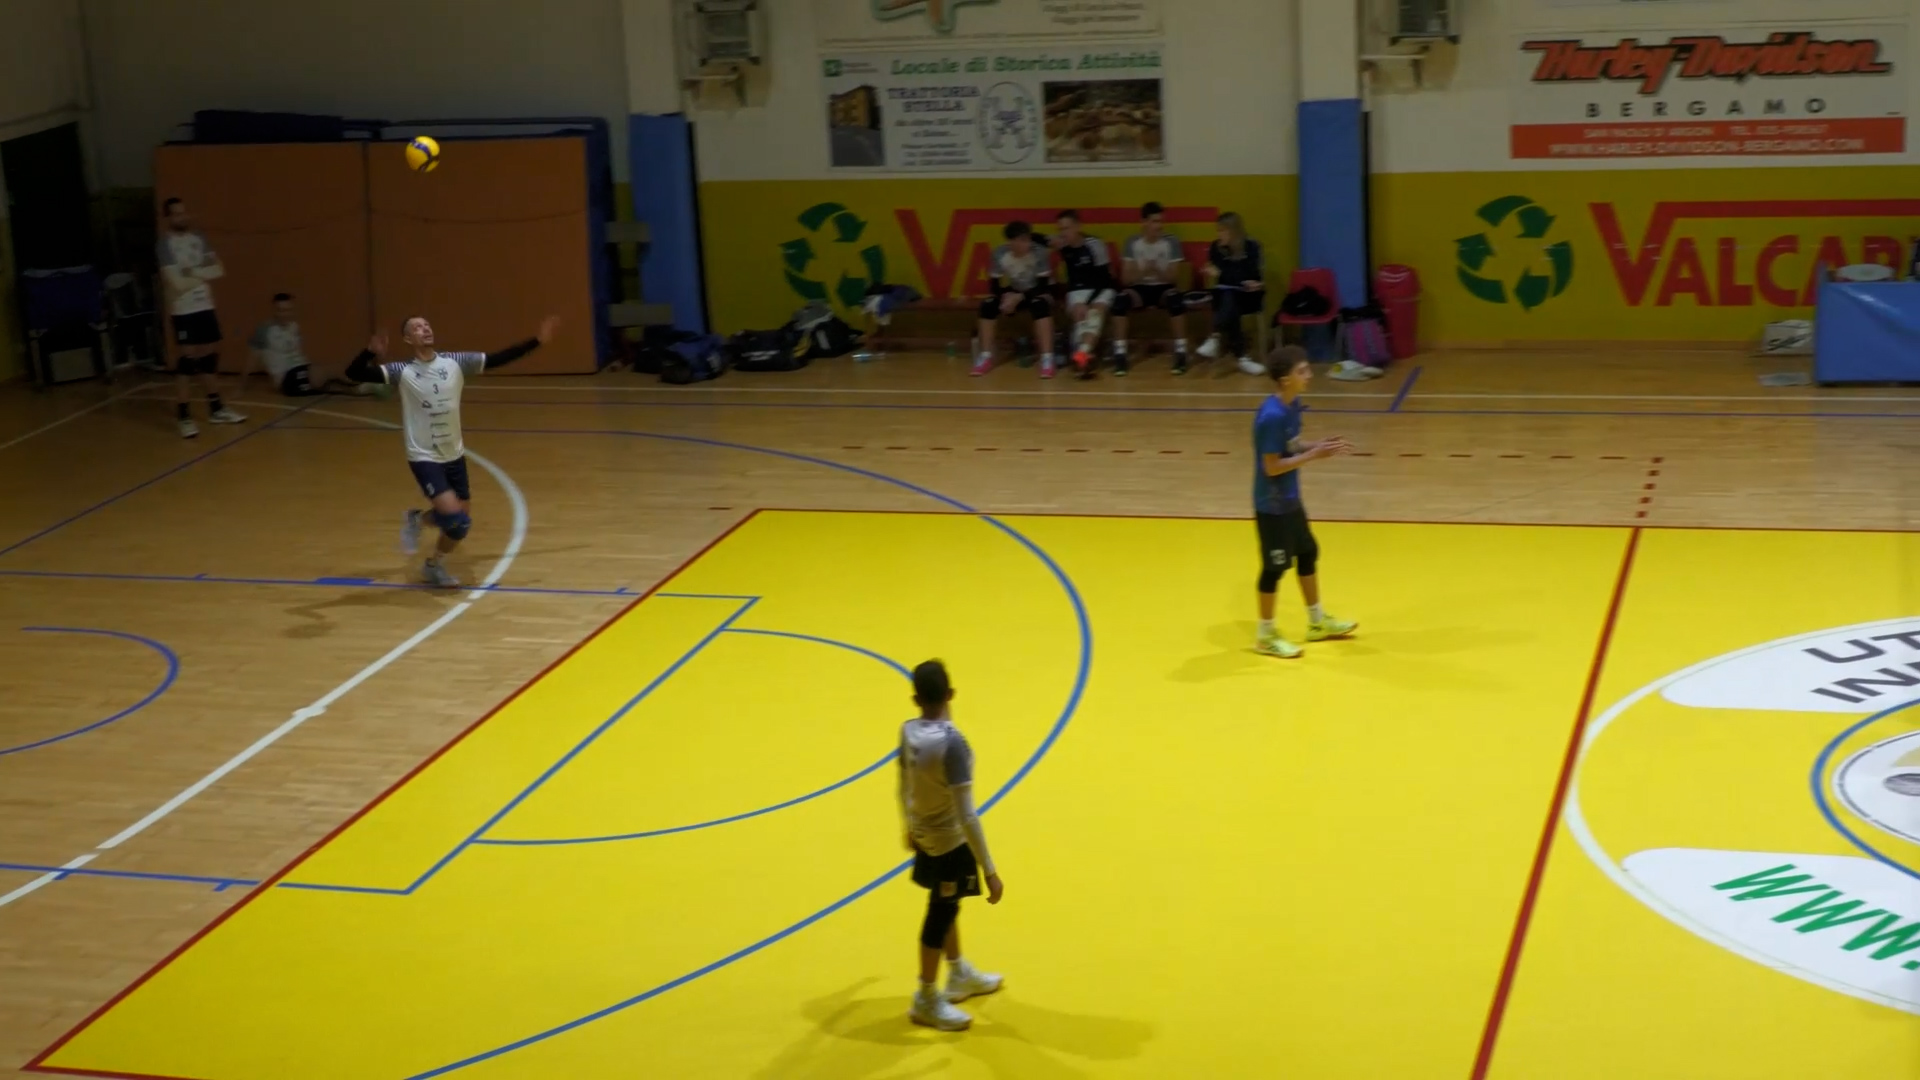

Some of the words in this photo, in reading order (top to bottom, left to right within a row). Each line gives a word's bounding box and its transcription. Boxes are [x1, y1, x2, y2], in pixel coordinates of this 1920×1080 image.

[892, 58, 960, 74] Locale
[965, 56, 988, 73] di
[993, 54, 1072, 71] Storica
[887, 86, 981, 99] TRATTORIA
[903, 101, 965, 112] STELLA
[1585, 98, 1826, 118] BERGAMO
[432, 383, 440, 395] 3
